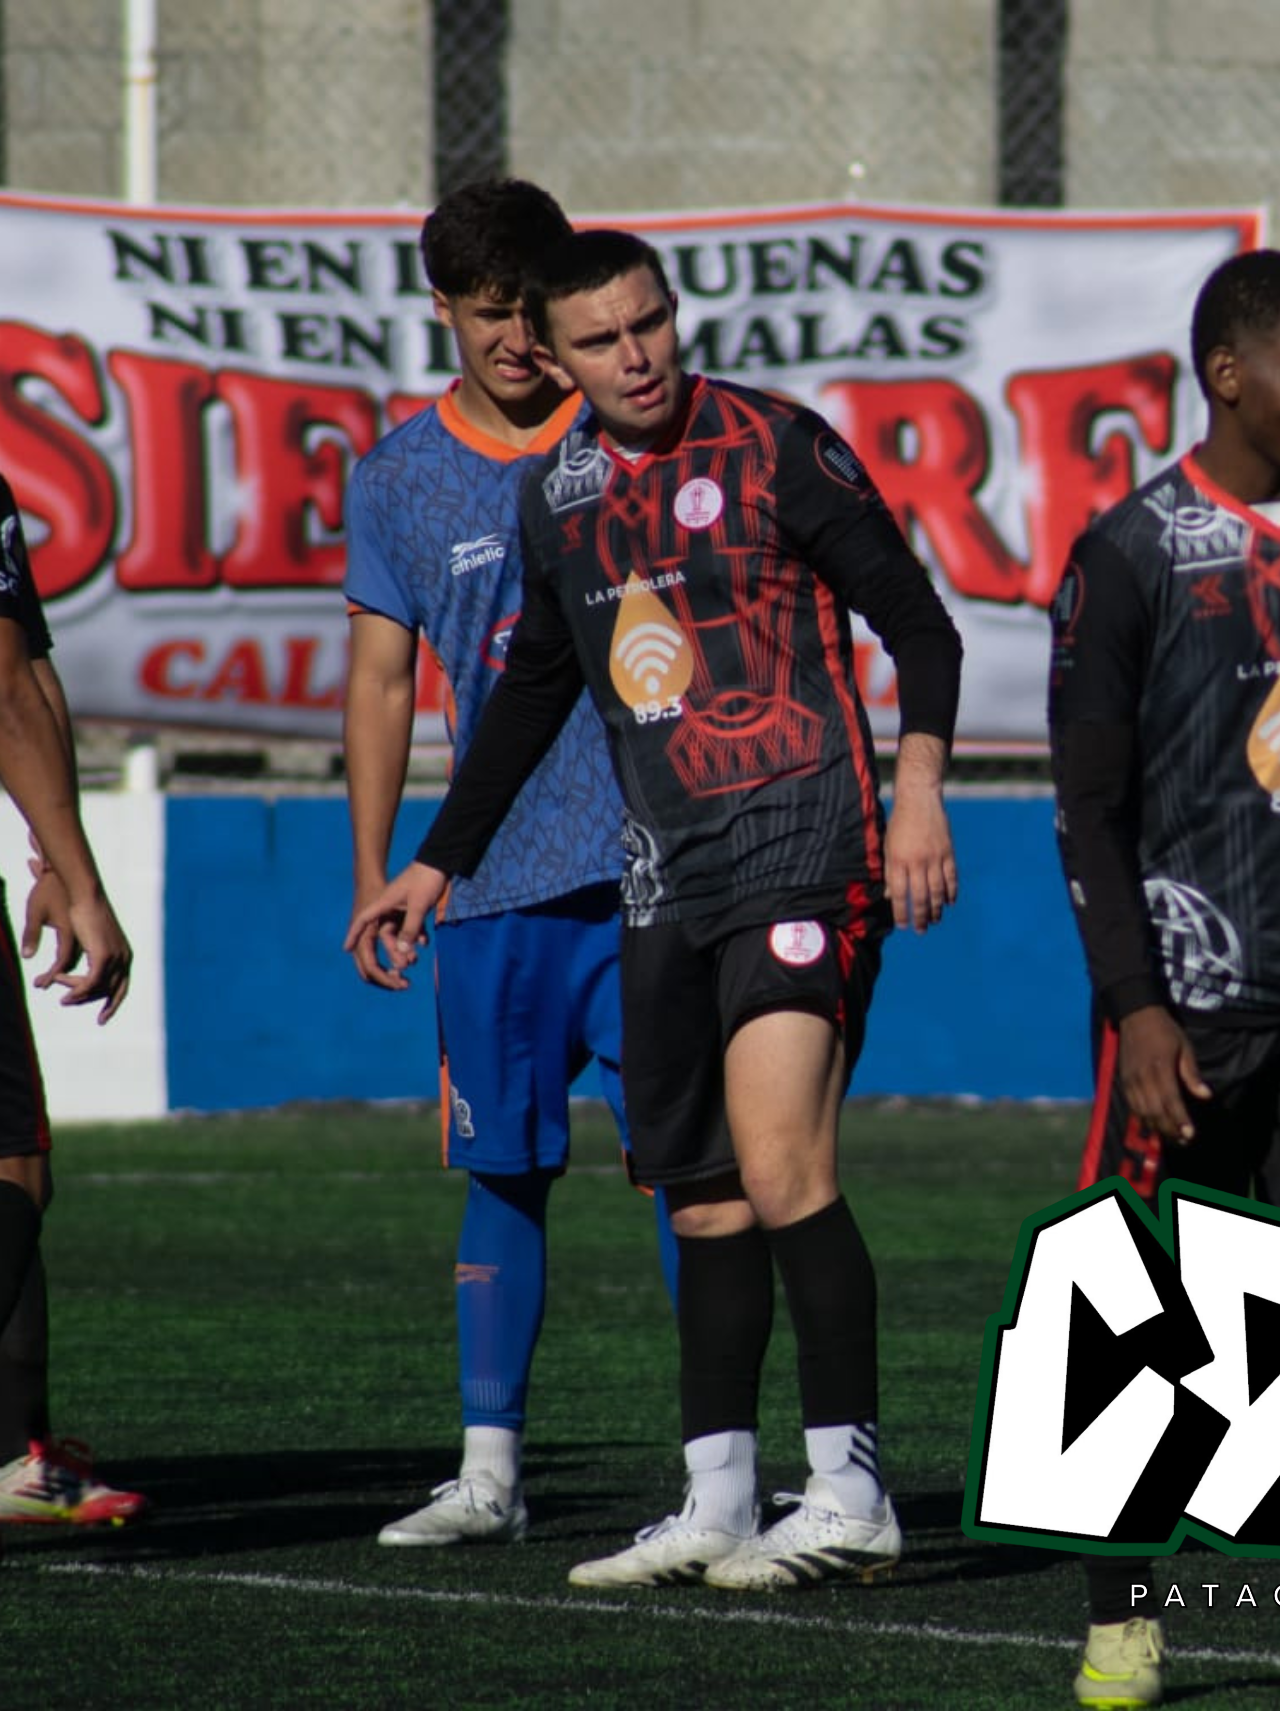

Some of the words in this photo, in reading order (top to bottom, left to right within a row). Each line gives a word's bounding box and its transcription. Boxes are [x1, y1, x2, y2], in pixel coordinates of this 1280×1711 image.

[107, 227, 222, 288] NI
[240, 239, 362, 295] EN
[668, 234, 986, 299] UENAS
[147, 301, 250, 352] NI
[279, 313, 393, 376] EN
[451, 545, 505, 576] athletic
[585, 590, 606, 606] LA
[607, 571, 687, 600] PETROLERA
[138, 635, 448, 712] CAL
[1236, 665, 1260, 680] LA
[633, 695, 683, 725] 89.3
